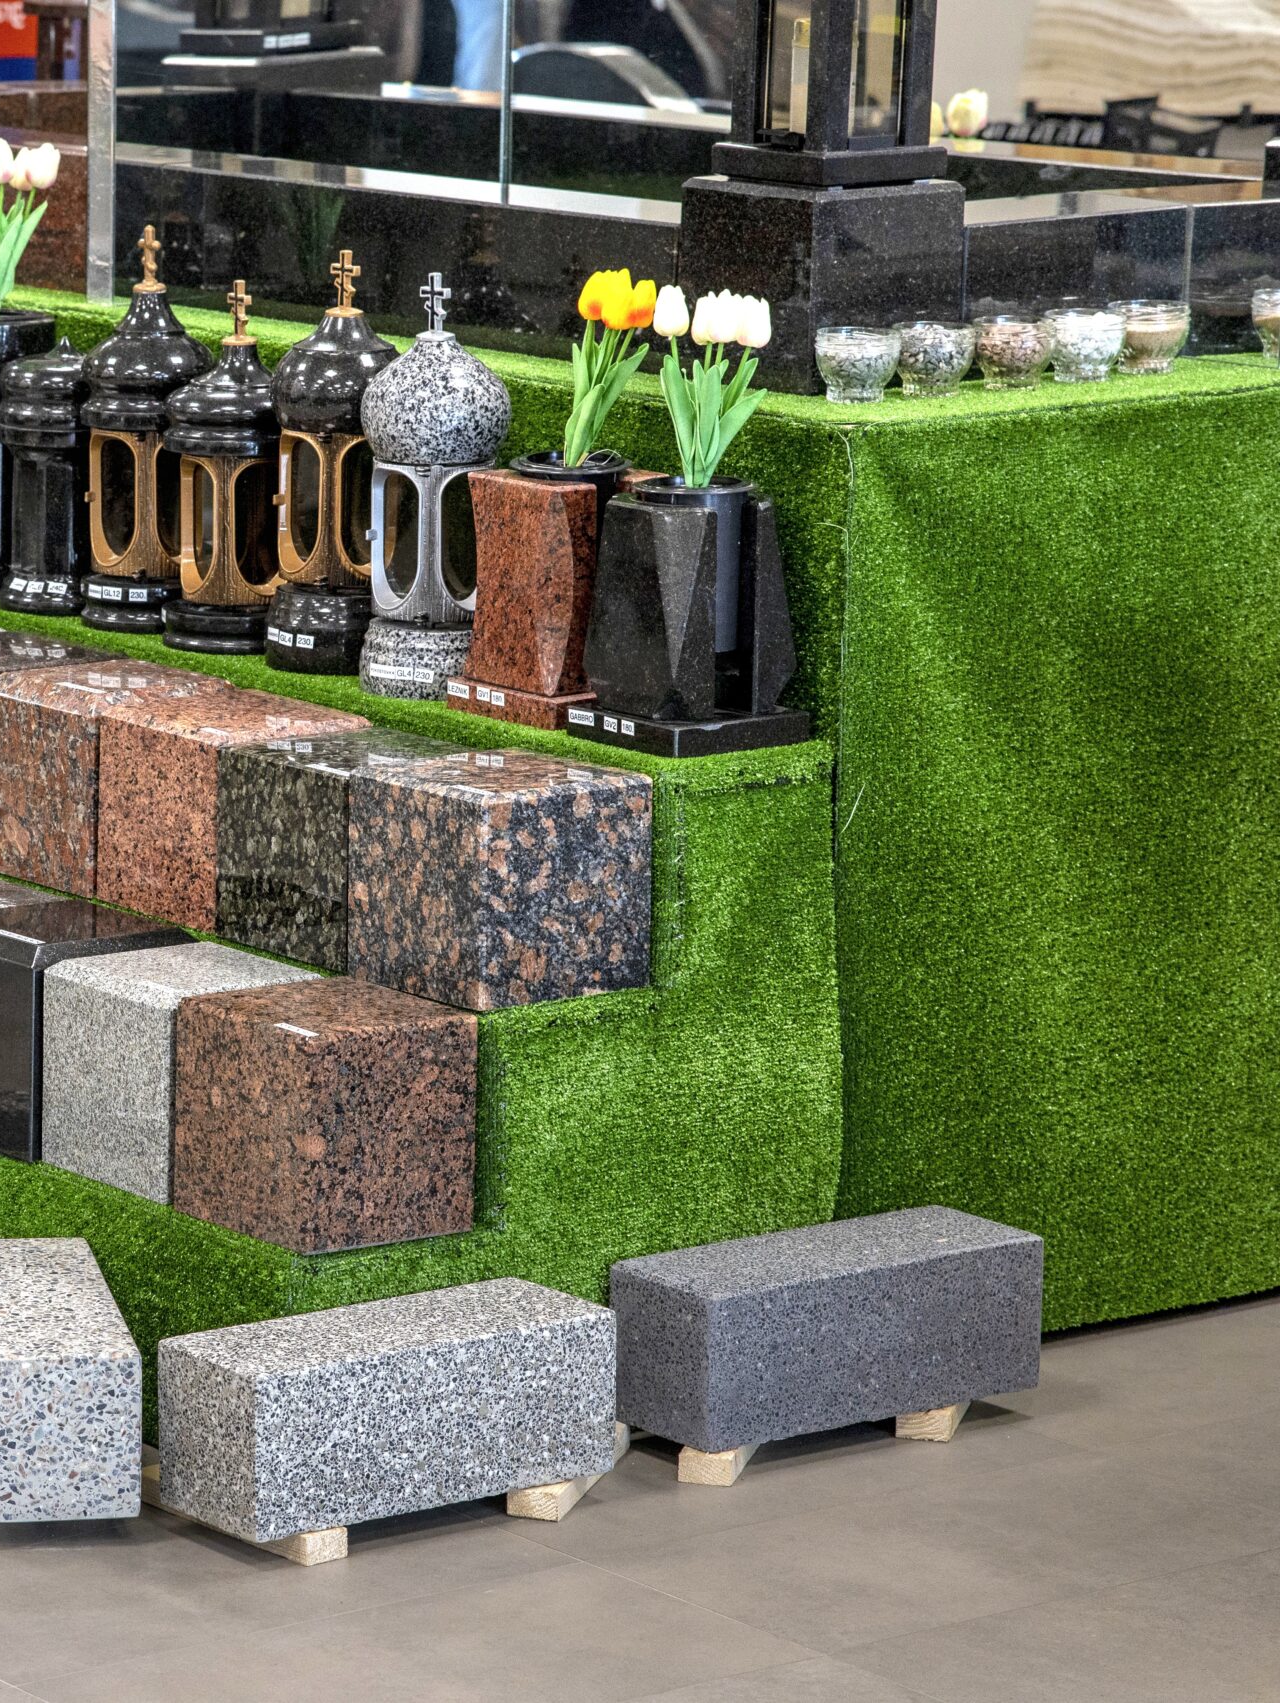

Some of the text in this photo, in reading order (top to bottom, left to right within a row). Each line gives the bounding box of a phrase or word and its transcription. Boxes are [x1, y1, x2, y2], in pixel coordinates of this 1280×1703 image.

[104, 588, 121, 598] GL12
[130, 591, 146, 599] 230.
[297, 637, 313, 646] 230.
[396, 669, 412, 678] GL4
[415, 671, 432, 680] 230.
[448, 684, 468, 696] LEZNIK
[477, 689, 489, 698] GV1
[570, 712, 593, 724] GABBRO
[604, 719, 617, 730] GV2
